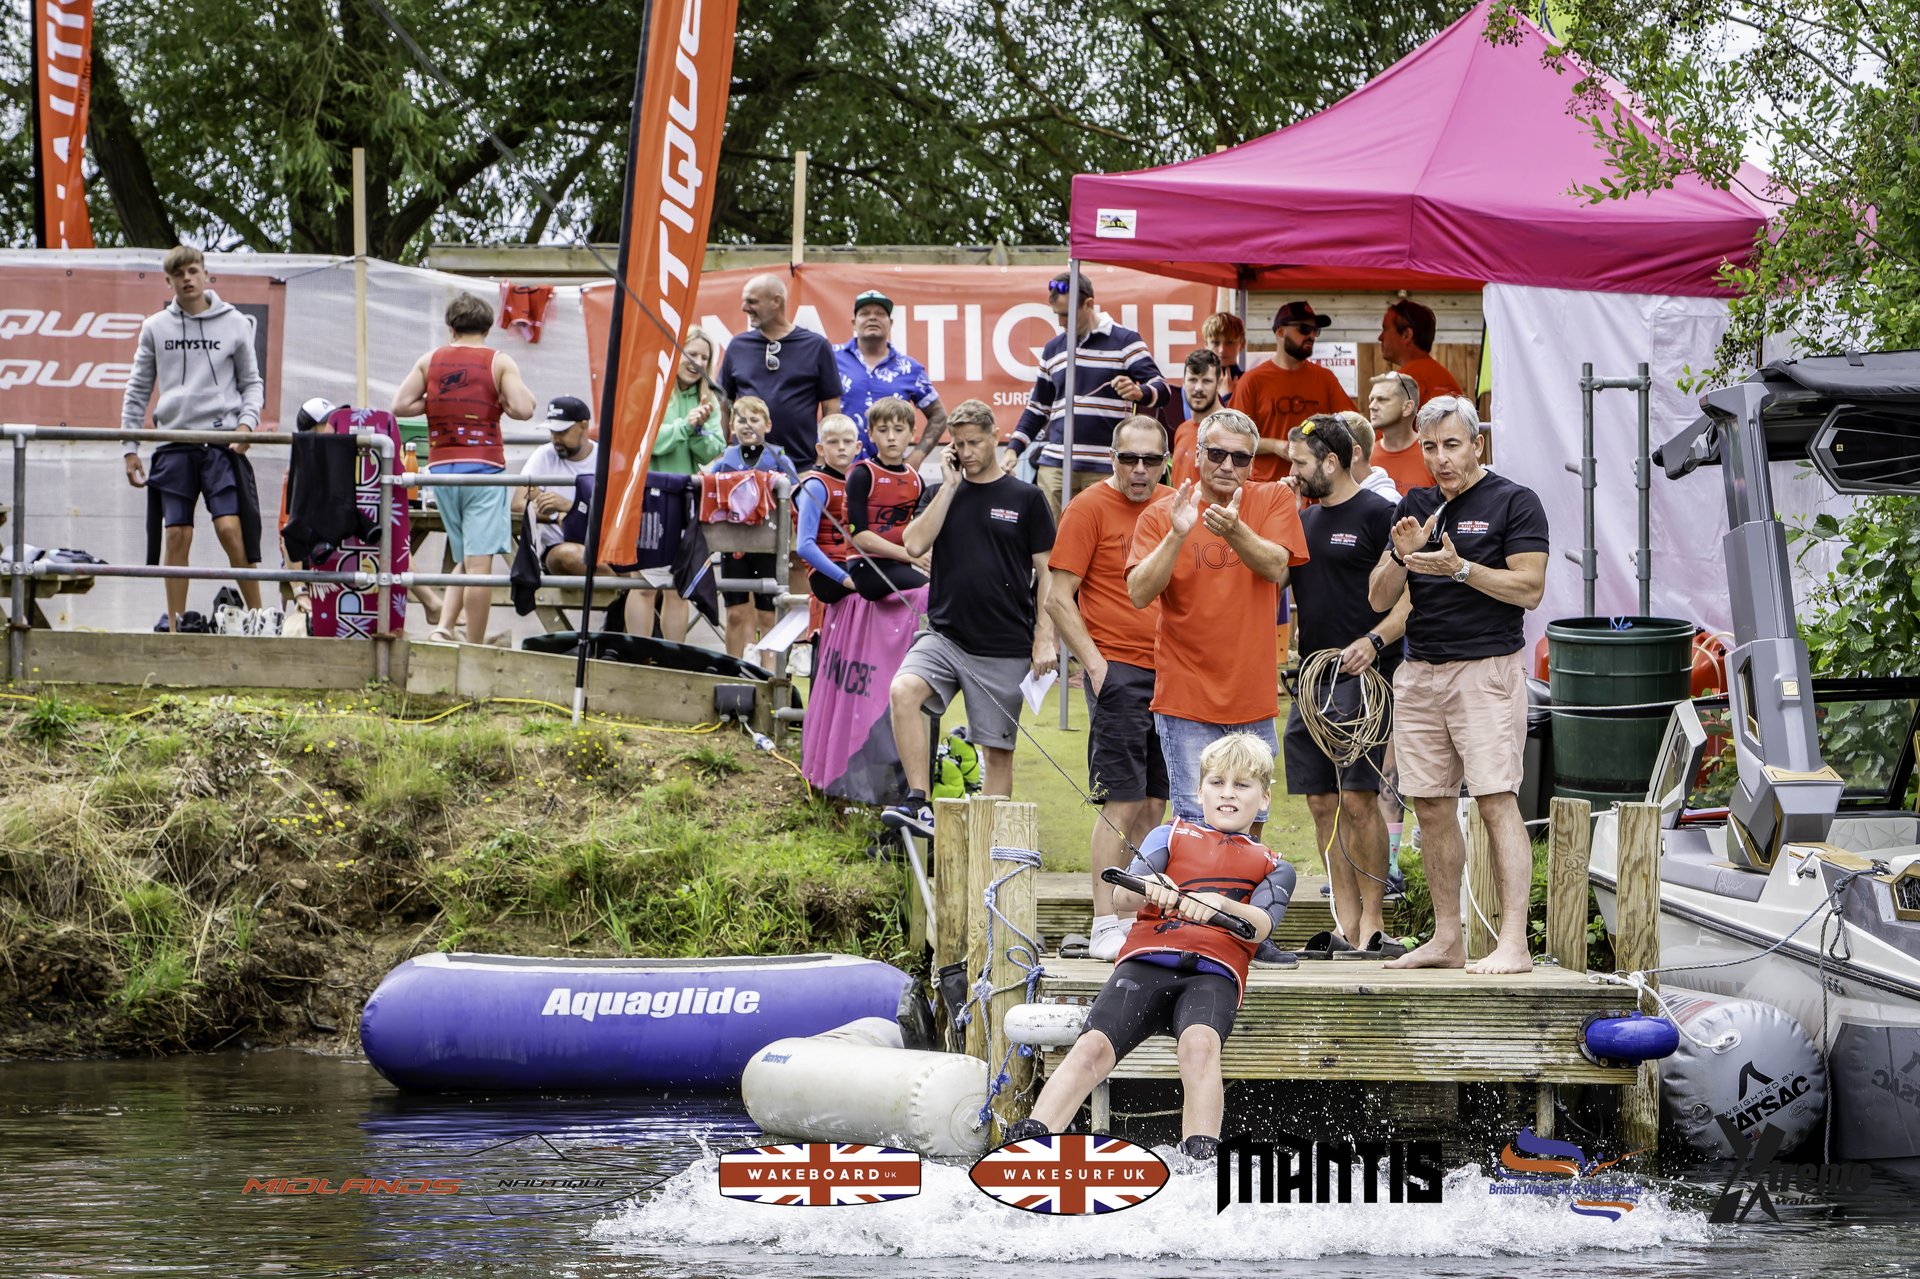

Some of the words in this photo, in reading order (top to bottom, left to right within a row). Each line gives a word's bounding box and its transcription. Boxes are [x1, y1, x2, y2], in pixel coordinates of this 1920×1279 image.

[175, 339, 221, 351] MYSTIC
[1722, 1081, 1780, 1117] WEIGHTED
[1781, 1070, 1795, 1084] BY
